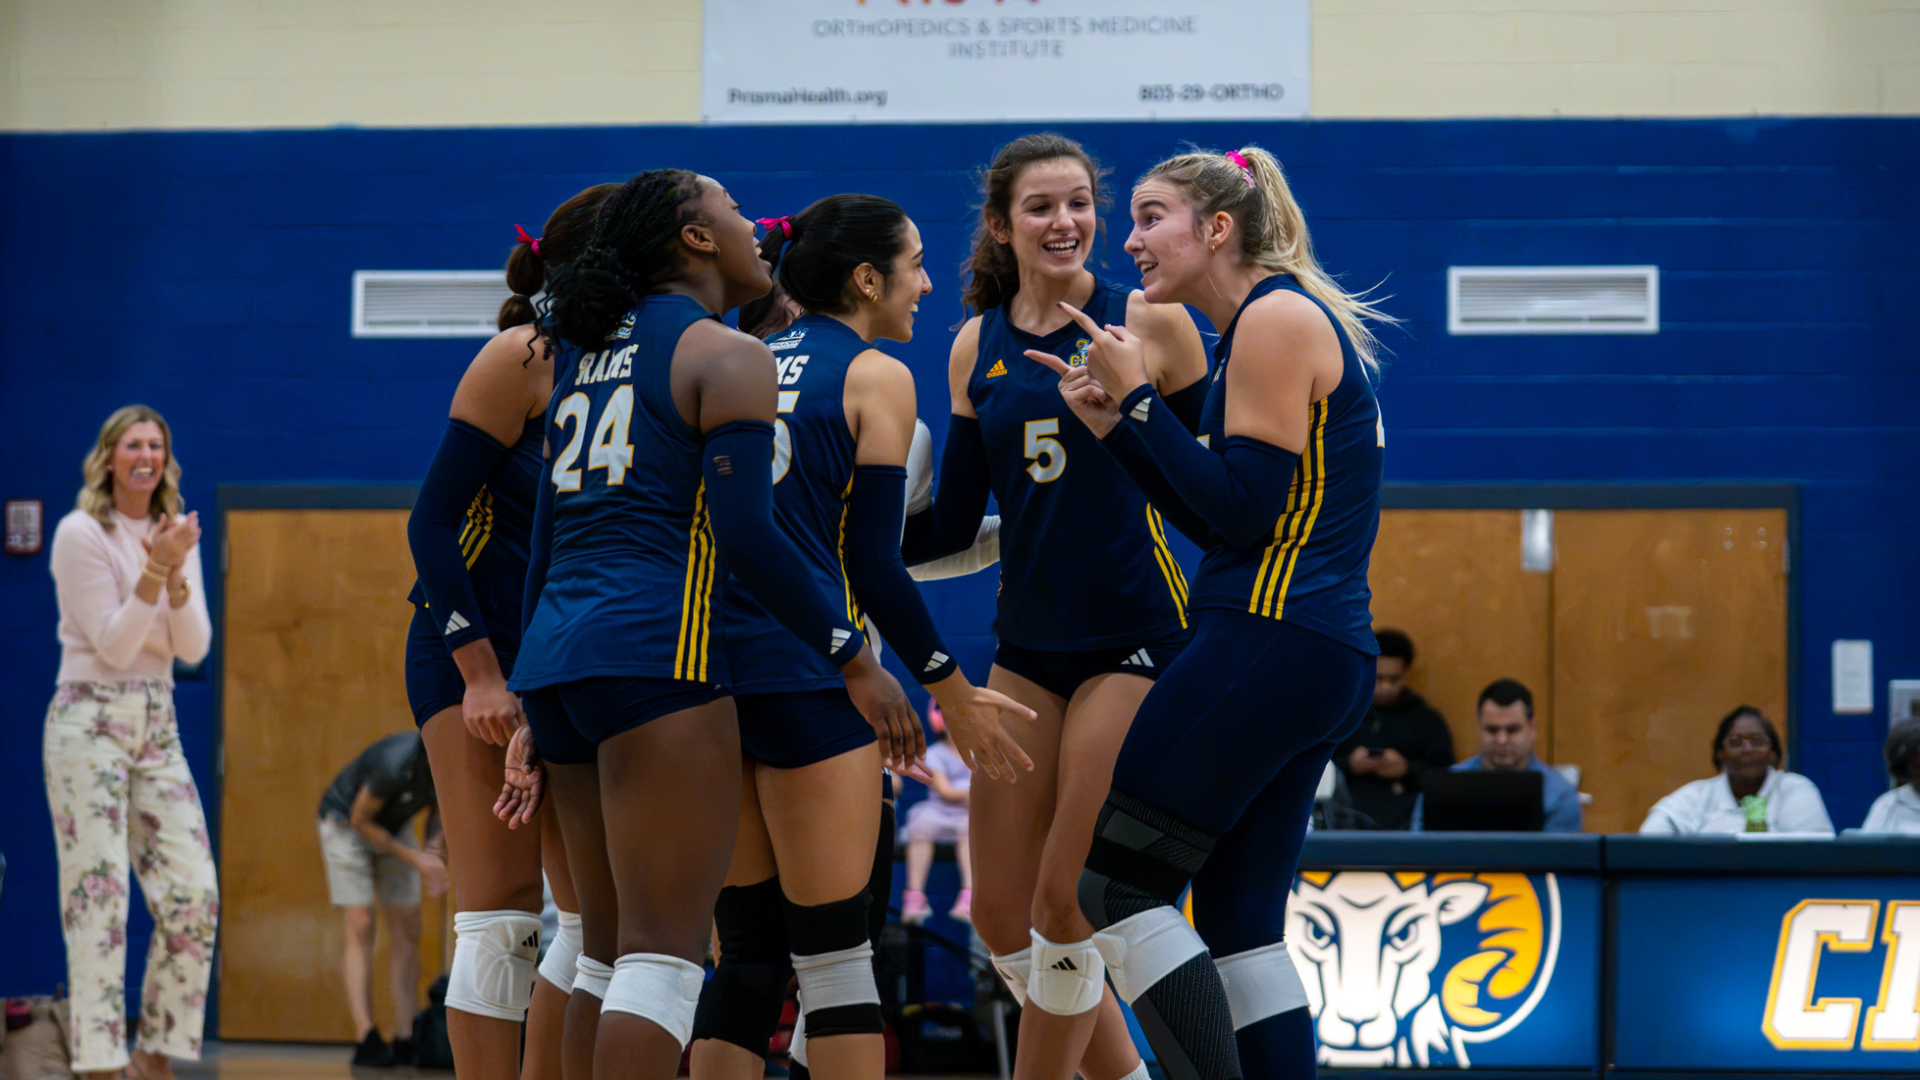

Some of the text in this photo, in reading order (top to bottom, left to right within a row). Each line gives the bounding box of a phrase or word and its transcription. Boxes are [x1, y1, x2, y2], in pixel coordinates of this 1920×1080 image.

[812, 15, 1197, 38] ORTHOPEDICS & SPORTS MEDICINE
[949, 40, 1063, 59] INSTITUTE
[728, 87, 888, 109] PrismaHealth.org
[575, 344, 639, 386] RAMS
[986, 369, 1008, 379] adidas
[552, 384, 634, 494] 24
[1024, 418, 1067, 484] 5
